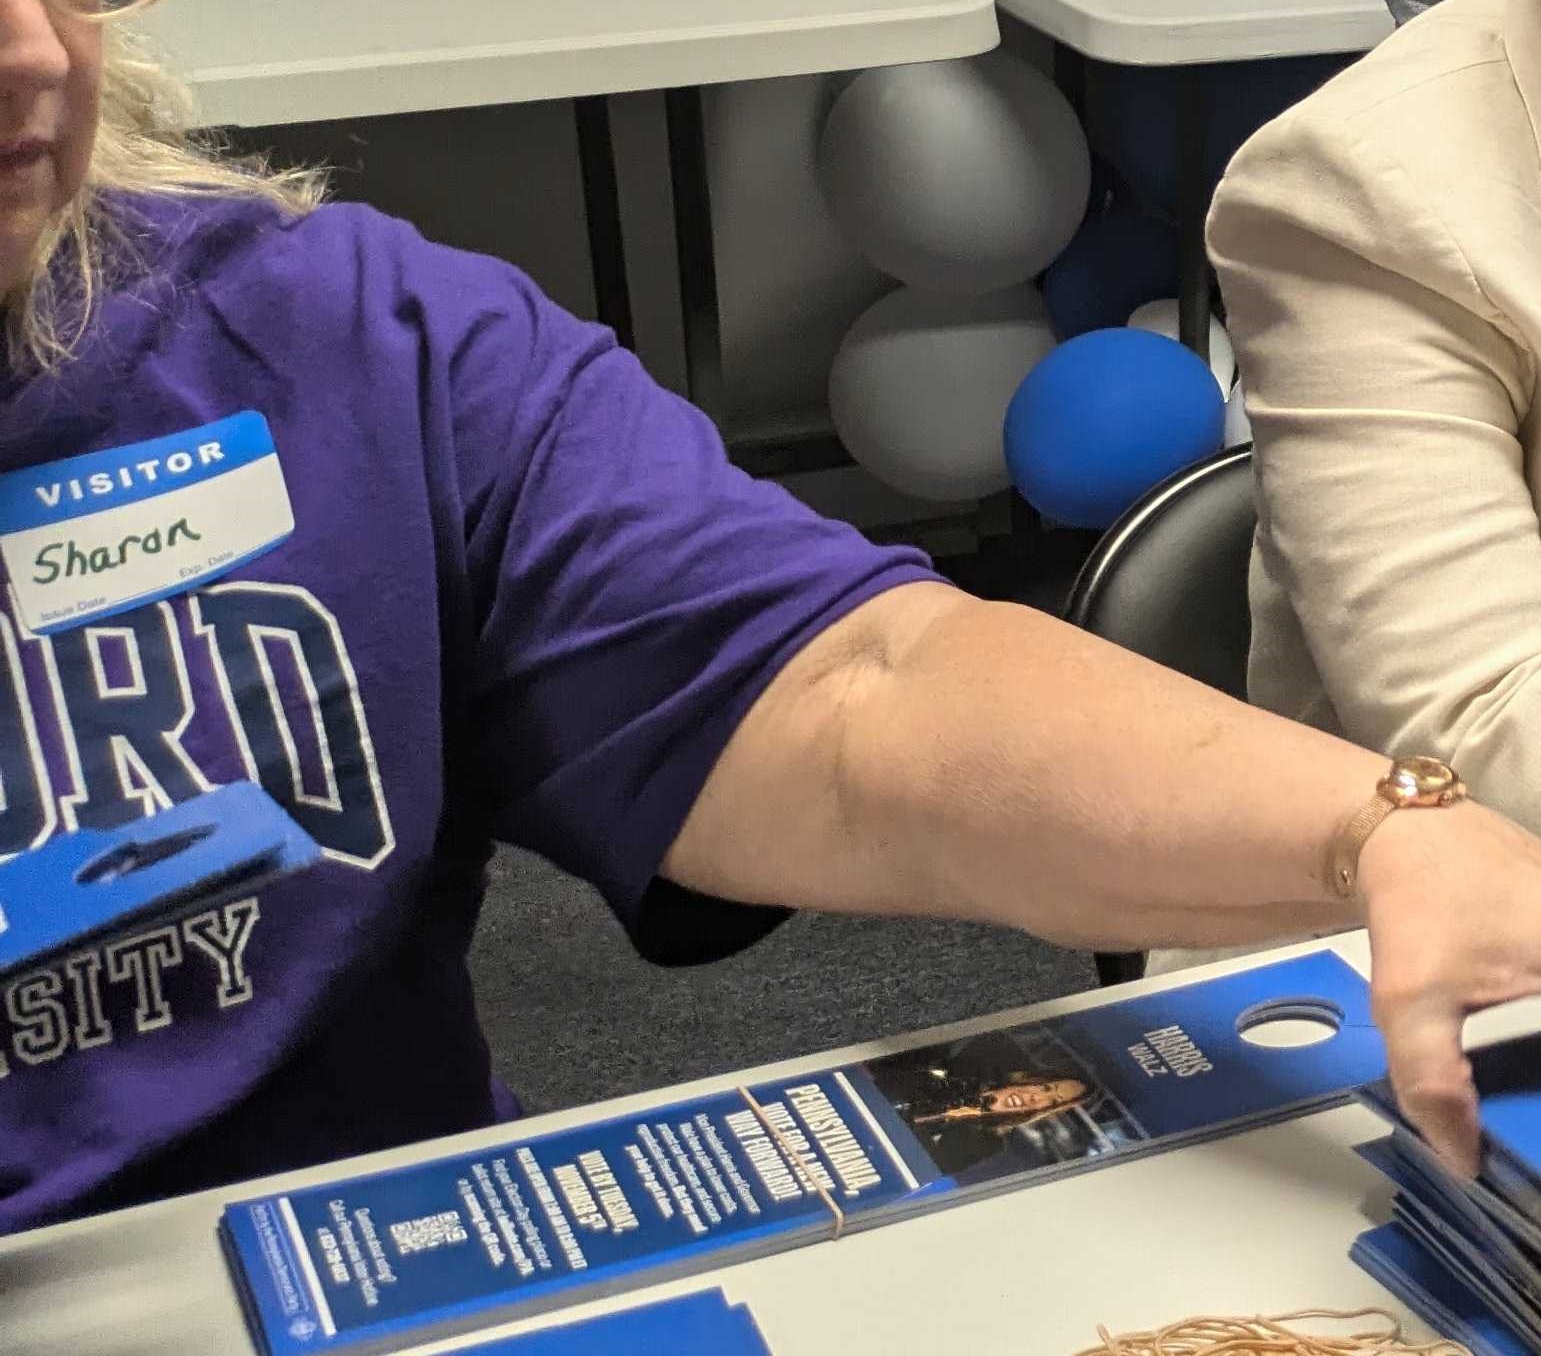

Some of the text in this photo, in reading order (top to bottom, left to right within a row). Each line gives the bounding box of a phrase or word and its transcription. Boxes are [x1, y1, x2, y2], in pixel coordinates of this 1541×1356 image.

[35, 440, 226, 509] VISITOR
[32, 517, 202, 585] Sharon
[77, 596, 107, 613] Date
[0, 897, 261, 1076] SITY
[1127, 1042, 1168, 1078] WALZ
[1144, 1025, 1213, 1077] HARRIS
[741, 1136, 802, 1201] FORWARD!
[785, 1083, 881, 1196] PENNSYLVANIA,
